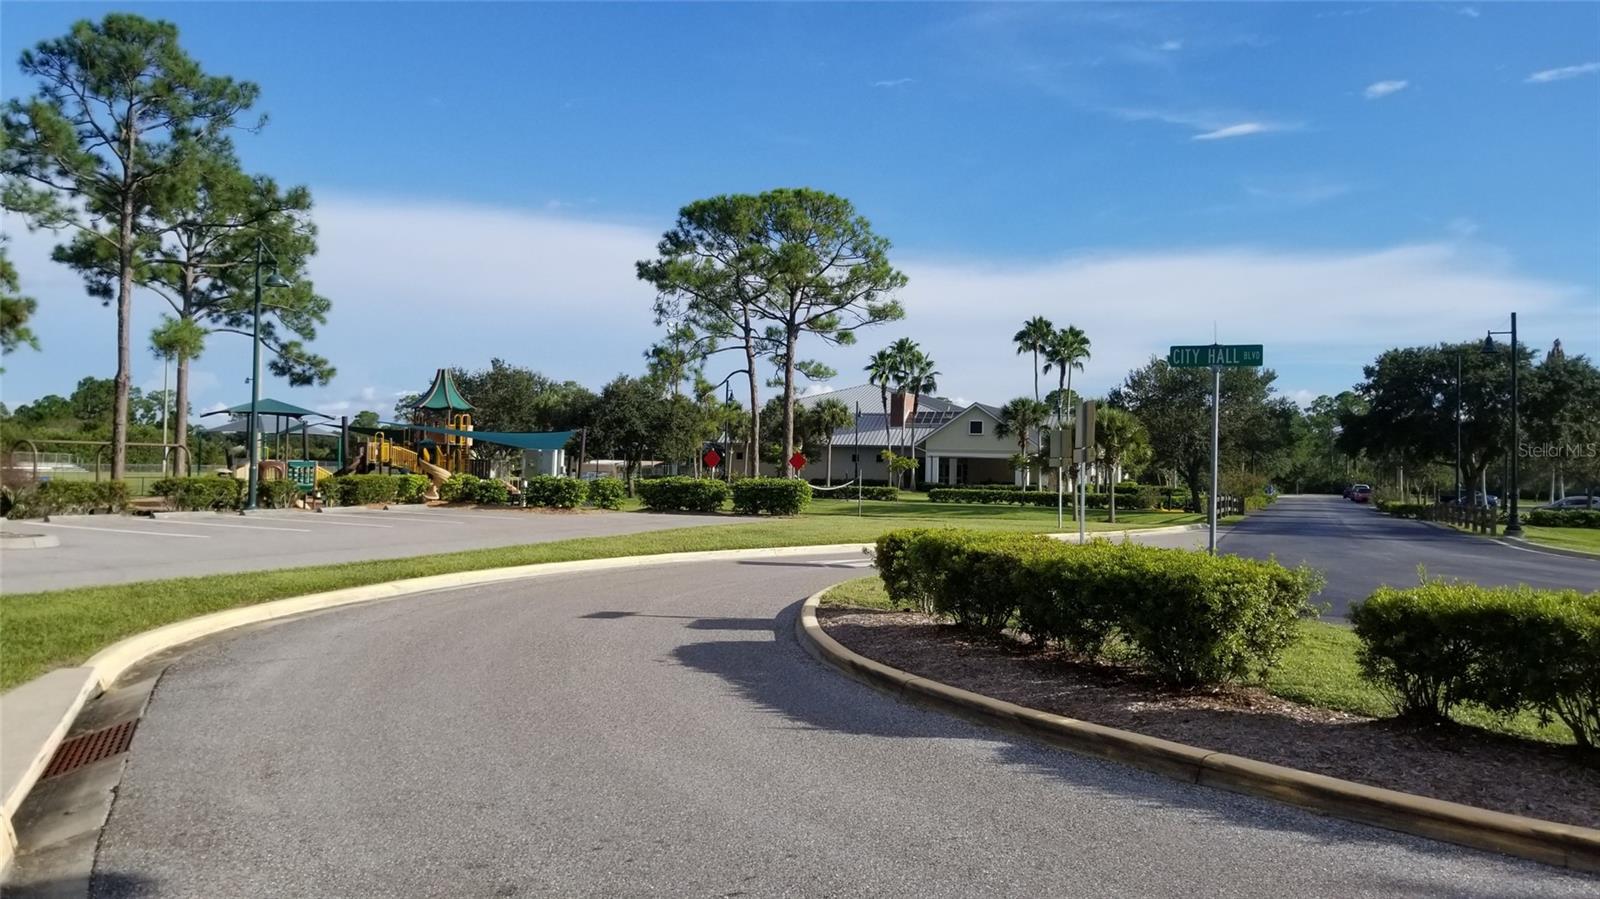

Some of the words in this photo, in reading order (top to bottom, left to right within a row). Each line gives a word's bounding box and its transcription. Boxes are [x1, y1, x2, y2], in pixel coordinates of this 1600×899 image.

[1173, 348, 1200, 365] CITY
[1208, 347, 1239, 364] HALL
[1243, 351, 1261, 360] BLVD
